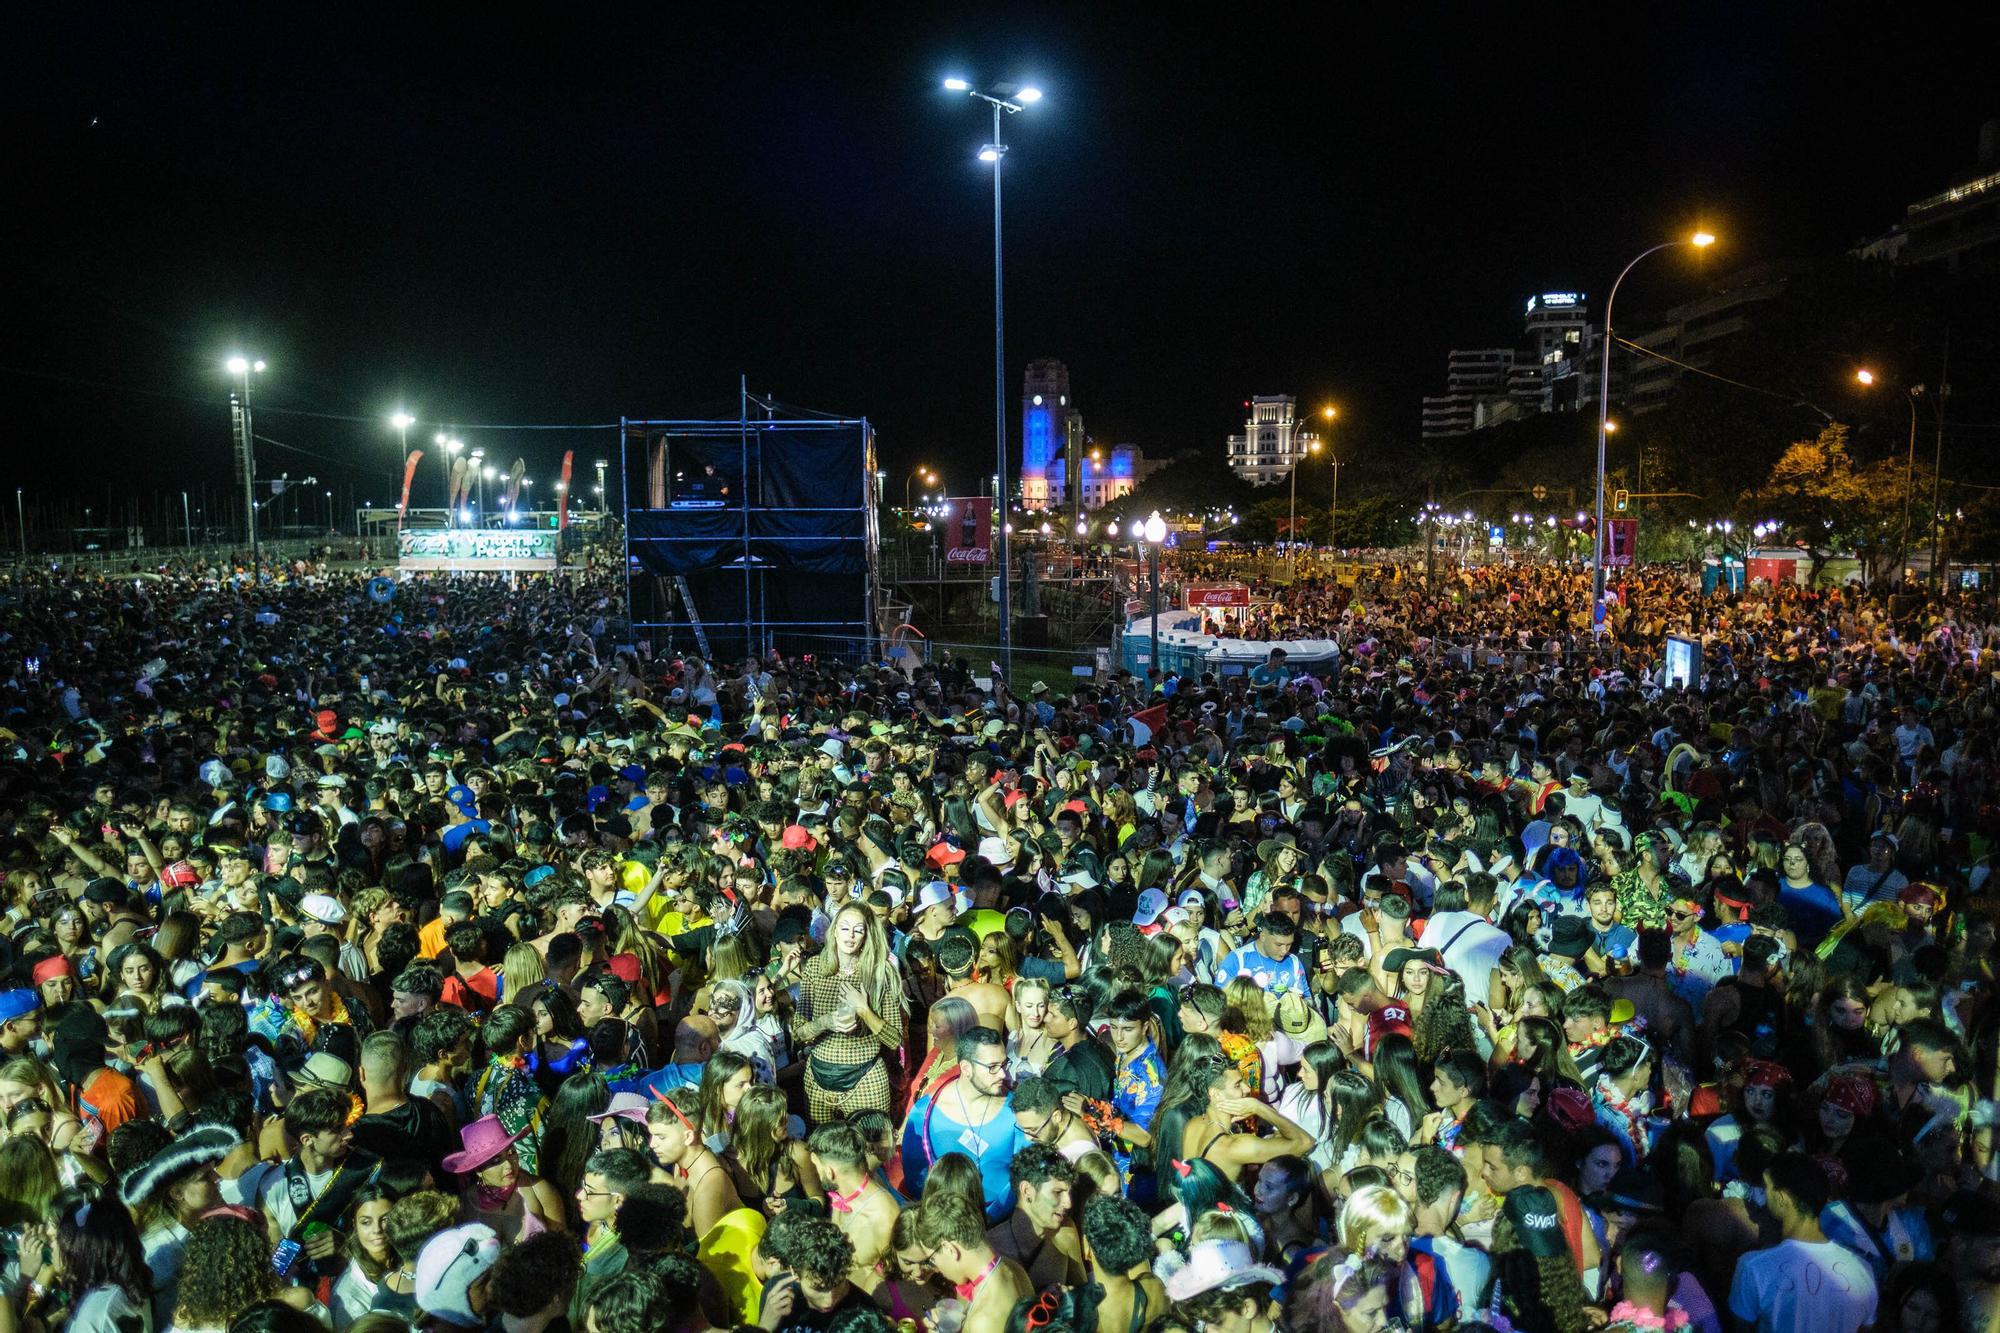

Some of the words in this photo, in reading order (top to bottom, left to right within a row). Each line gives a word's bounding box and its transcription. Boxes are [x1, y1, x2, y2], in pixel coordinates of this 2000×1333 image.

[1494, 528, 1500, 536] P
[477, 545, 531, 558] Pedrito
[947, 547, 988, 561] Coca-Cola
[1203, 591, 1233, 602] Coca-Cola
[1384, 1007, 1406, 1021] 97
[1524, 1213, 1557, 1229] SWAT
